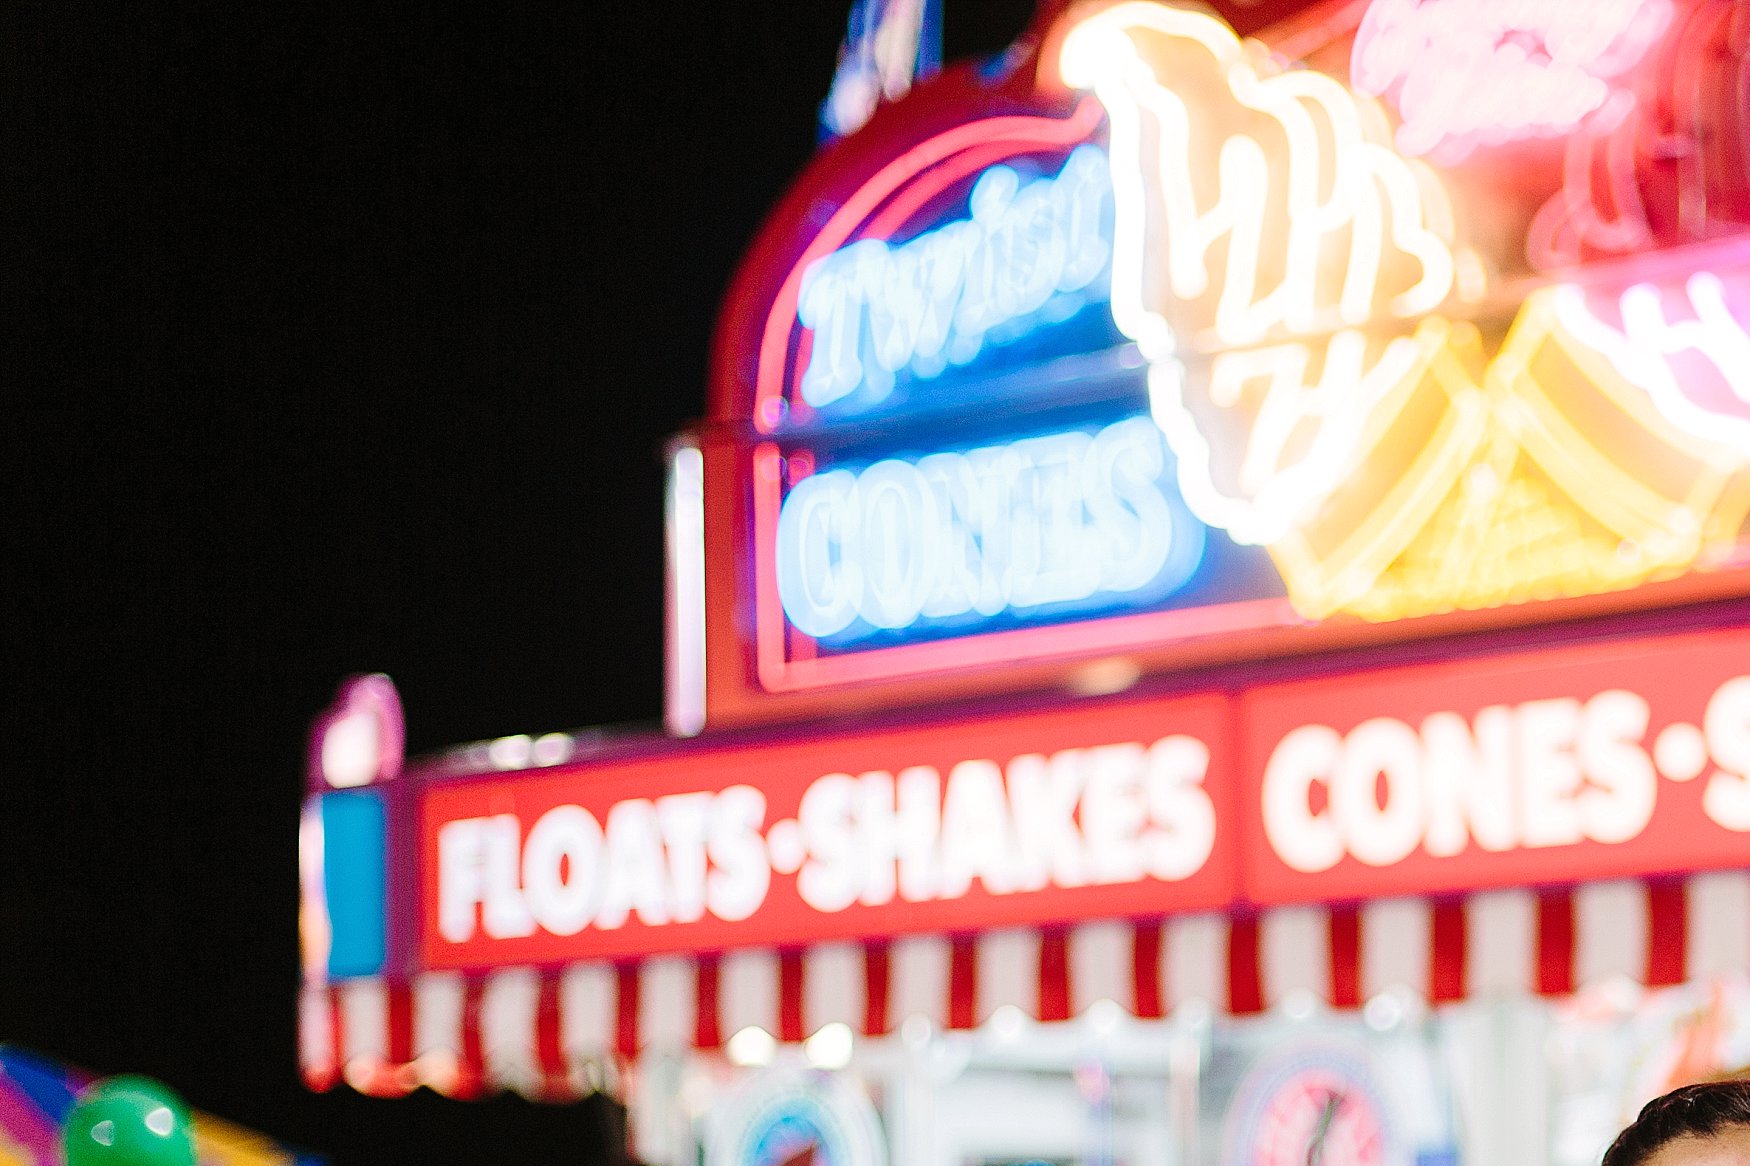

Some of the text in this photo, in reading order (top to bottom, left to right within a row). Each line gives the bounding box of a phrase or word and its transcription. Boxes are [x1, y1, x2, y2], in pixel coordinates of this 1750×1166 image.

[776, 415, 1180, 637] CONES
[435, 735, 1217, 942] FLOATS SHAKES
[1260, 690, 1658, 873] CONES
